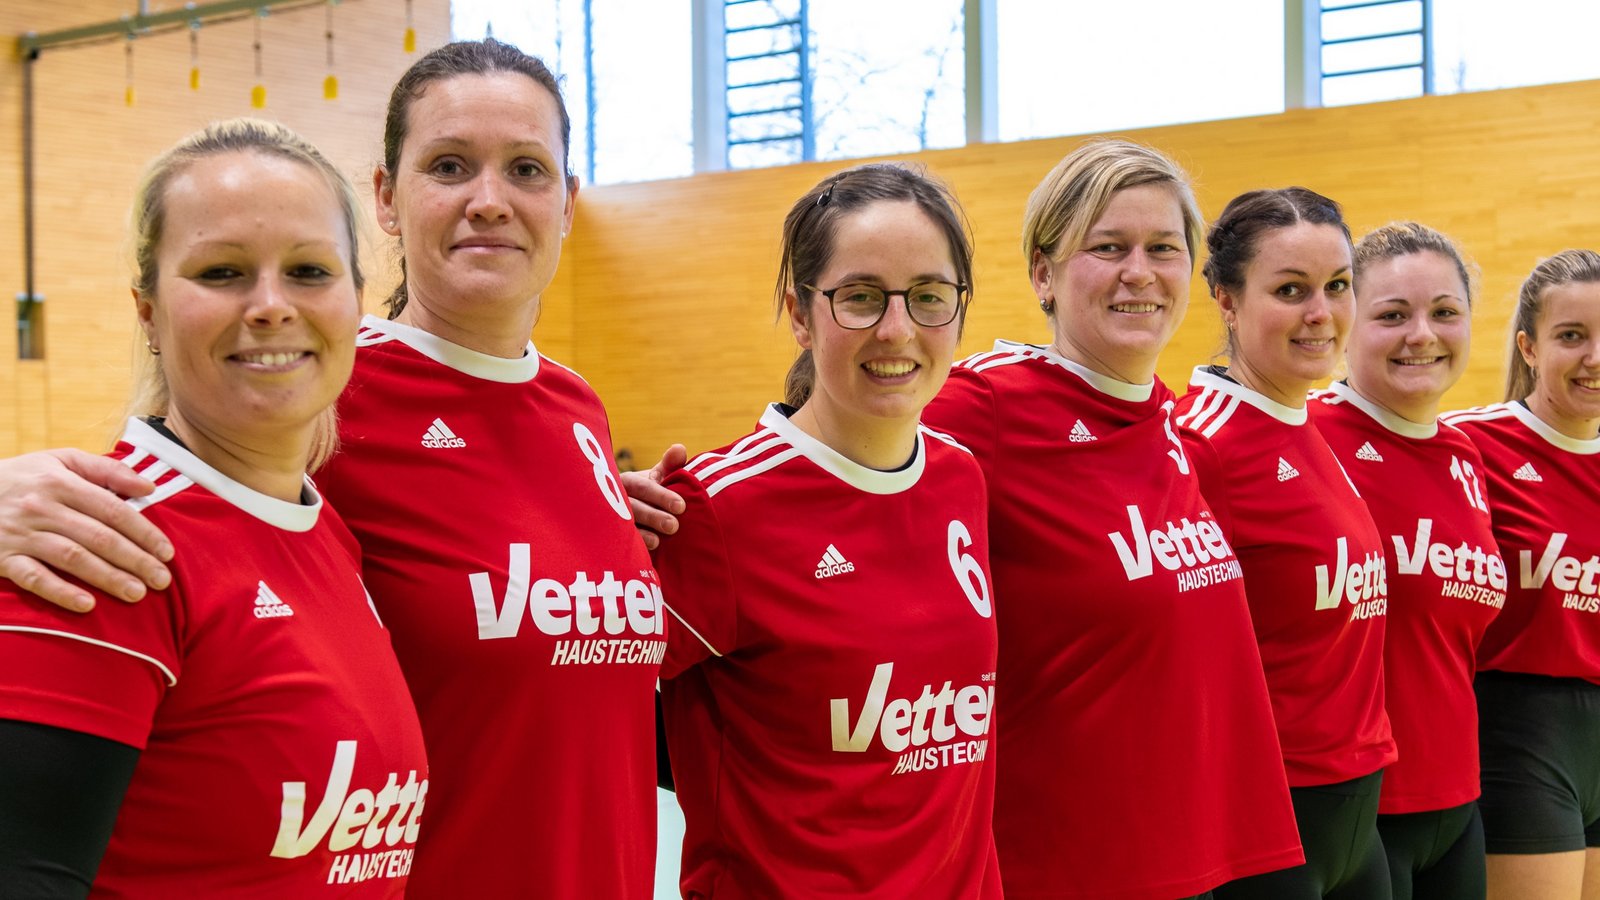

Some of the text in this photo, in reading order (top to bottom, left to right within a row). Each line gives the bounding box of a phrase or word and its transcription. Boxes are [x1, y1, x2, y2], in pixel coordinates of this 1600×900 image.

[421, 438, 467, 449] adidas
[572, 422, 632, 520] 8
[1449, 454, 1489, 514] 12
[468, 543, 664, 640] Vetter
[815, 561, 855, 579] adidas
[948, 519, 992, 618] 6
[1519, 532, 1600, 597] Vet
[1562, 592, 1600, 613] HAUS
